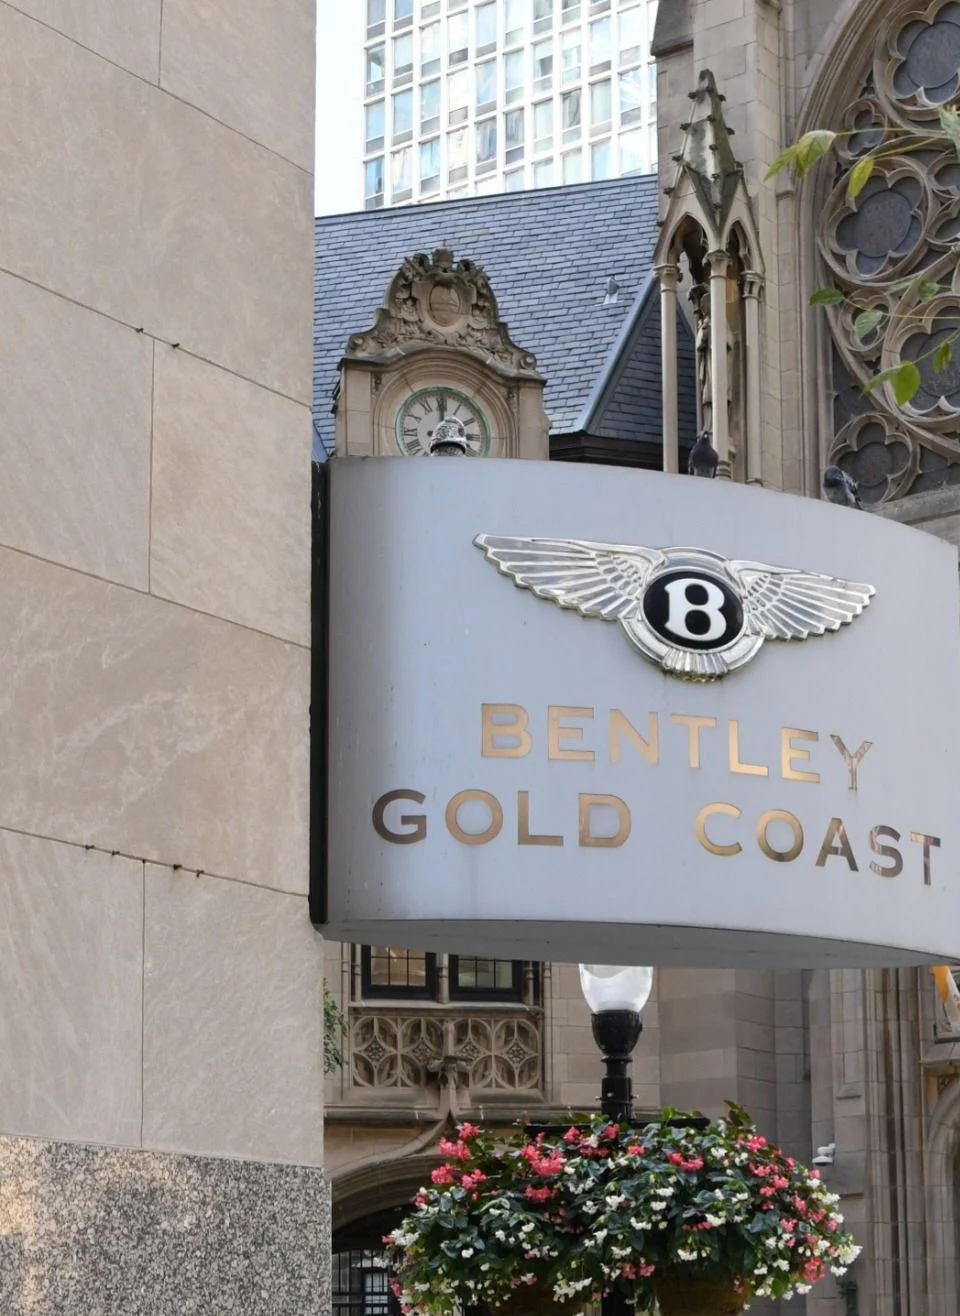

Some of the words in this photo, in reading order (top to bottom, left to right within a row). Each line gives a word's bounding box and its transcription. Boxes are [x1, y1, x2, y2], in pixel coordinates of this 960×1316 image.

[664, 578, 727, 641] B
[480, 703, 873, 791] BENTLEY
[372, 788, 632, 847] GOLD
[695, 802, 941, 885] COAST
